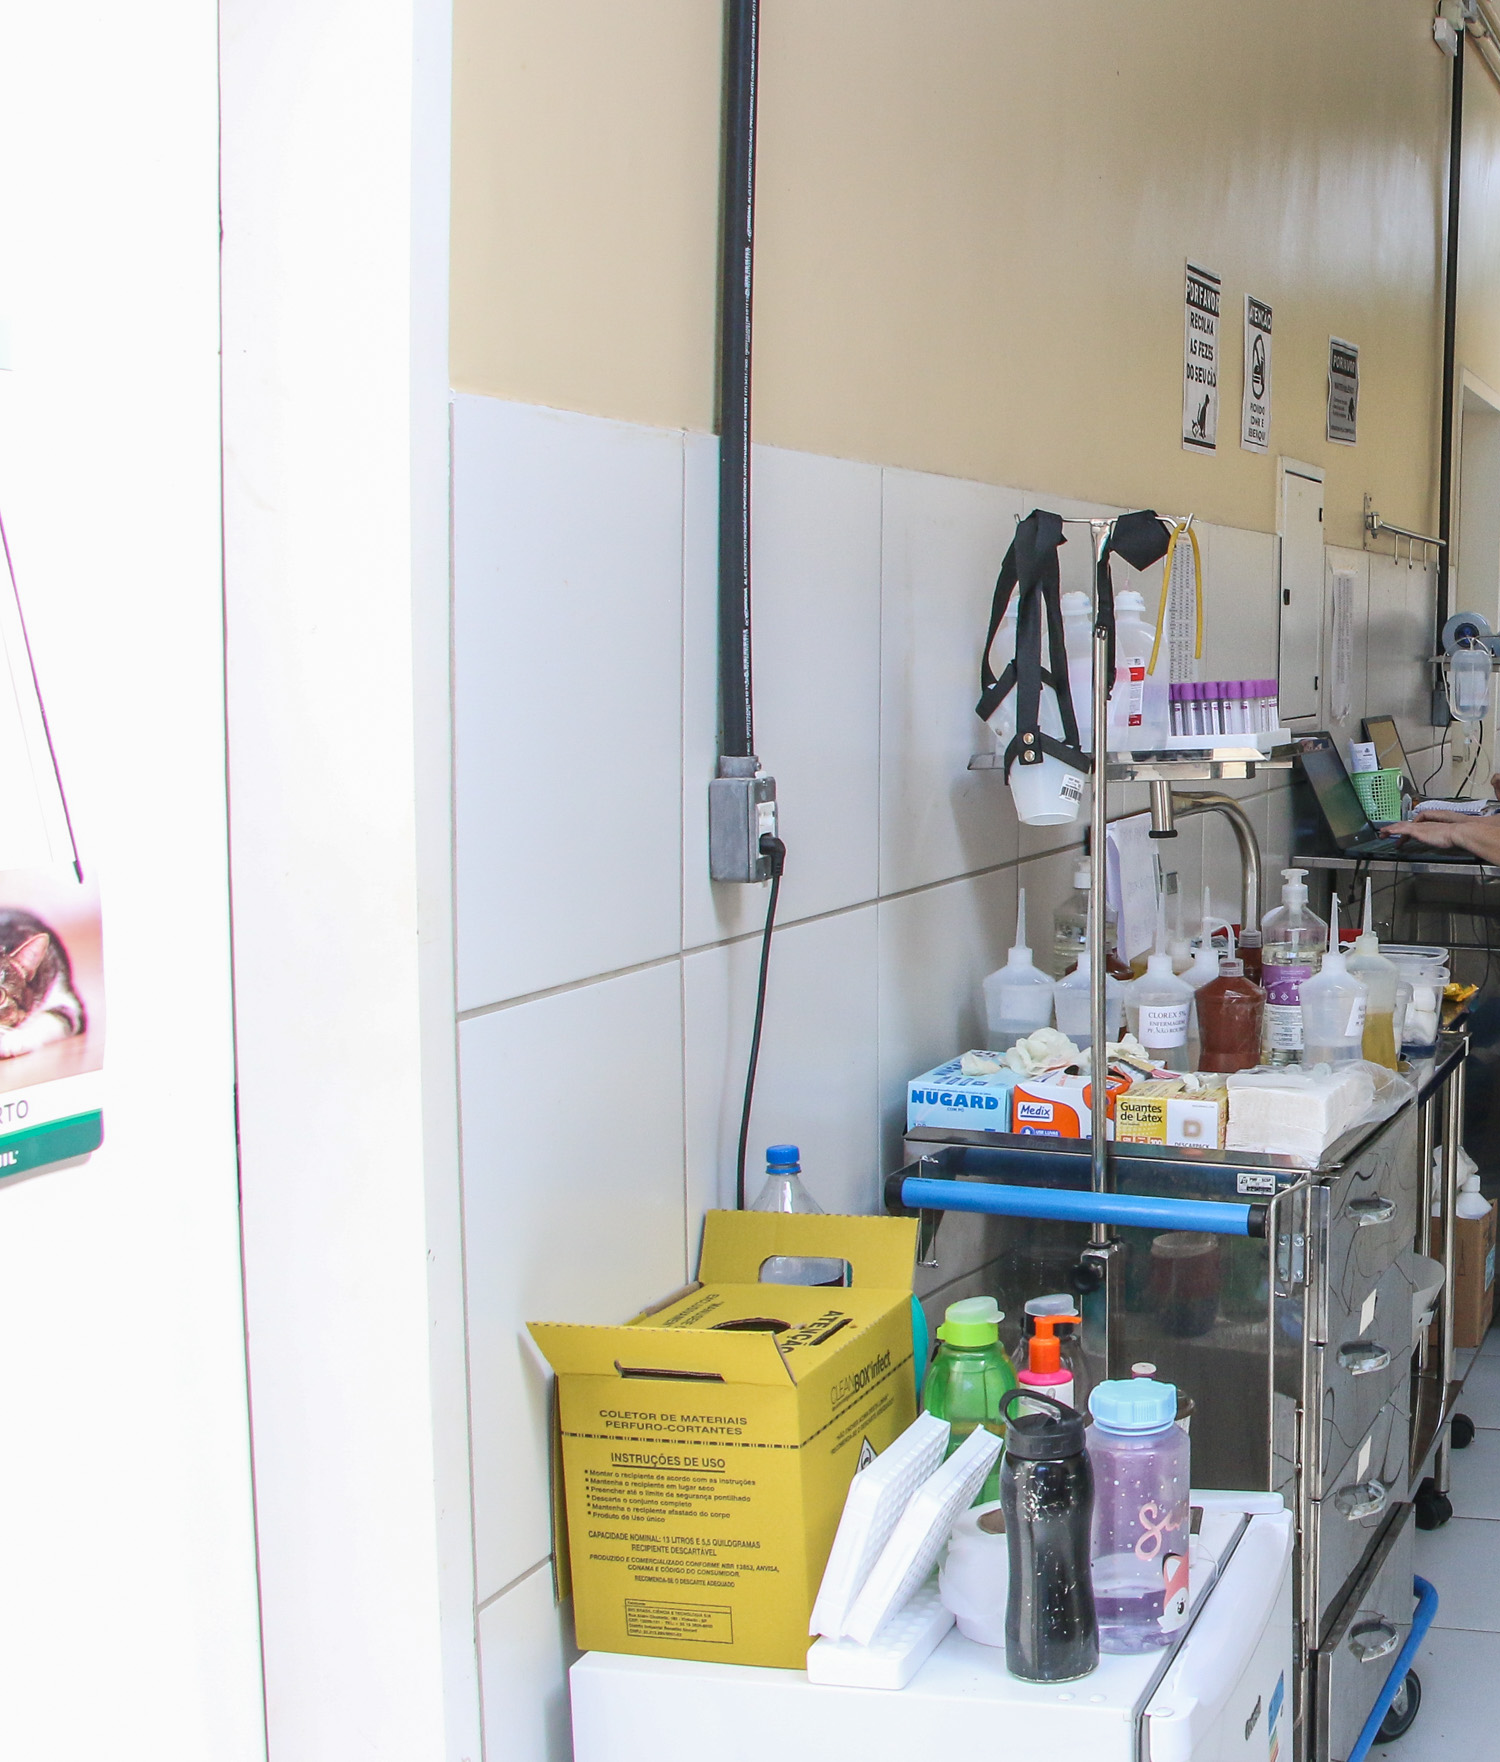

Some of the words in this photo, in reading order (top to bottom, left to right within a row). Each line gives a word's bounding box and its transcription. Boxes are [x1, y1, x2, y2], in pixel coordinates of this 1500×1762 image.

[1190, 312, 1214, 335] RECOLHA
[1190, 338, 1198, 355] AS
[1198, 341, 1214, 361] FEZES
[1187, 363, 1194, 379] DO
[1195, 365, 1207, 384] SEU
[911, 1089, 999, 1110] NUGARD
[1020, 1104, 1051, 1116] Medix
[1120, 1101, 1162, 1113] Guantes
[1120, 1112, 1133, 1121] de
[1136, 1112, 1162, 1123] Látex
[599, 1410, 656, 1420] COLETOR
[681, 1415, 748, 1425] MATERIAIS
[605, 1421, 742, 1435] PERFURO-CORTANTES
[611, 1452, 680, 1467] INSTRUÇÕES
[684, 1457, 699, 1466] DE
[702, 1458, 726, 1468] USO
[590, 1469, 613, 1477] Montar
[621, 1472, 654, 1480] recipiente
[719, 1477, 756, 1487] instruções
[590, 1478, 623, 1486] Mantenha
[631, 1481, 664, 1489] recipiente
[679, 1483, 696, 1491] lugar
[591, 1486, 625, 1495] Preencher
[676, 1492, 712, 1501] segurança
[592, 1503, 625, 1511] Mantenha
[633, 1506, 666, 1514] recipiente
[629, 1498, 658, 1506] conjunto
[660, 1499, 692, 1507] completo
[592, 1511, 619, 1519] Produto
[588, 1530, 628, 1540] CAPACIDADE
[630, 1533, 661, 1542] NOMINAL:
[671, 1537, 694, 1545] LITROS
[712, 1539, 761, 1548] QUILOGRAMAS
[631, 1544, 669, 1554] RECIPIENTE
[670, 1547, 717, 1556] DESCARTÁVEL
[589, 1554, 625, 1562] PRODUZIDO
[631, 1557, 684, 1566] COMERCIALIZADO
[756, 1565, 779, 1573] ANVISA,
[660, 1565, 685, 1574] CÓDIGO
